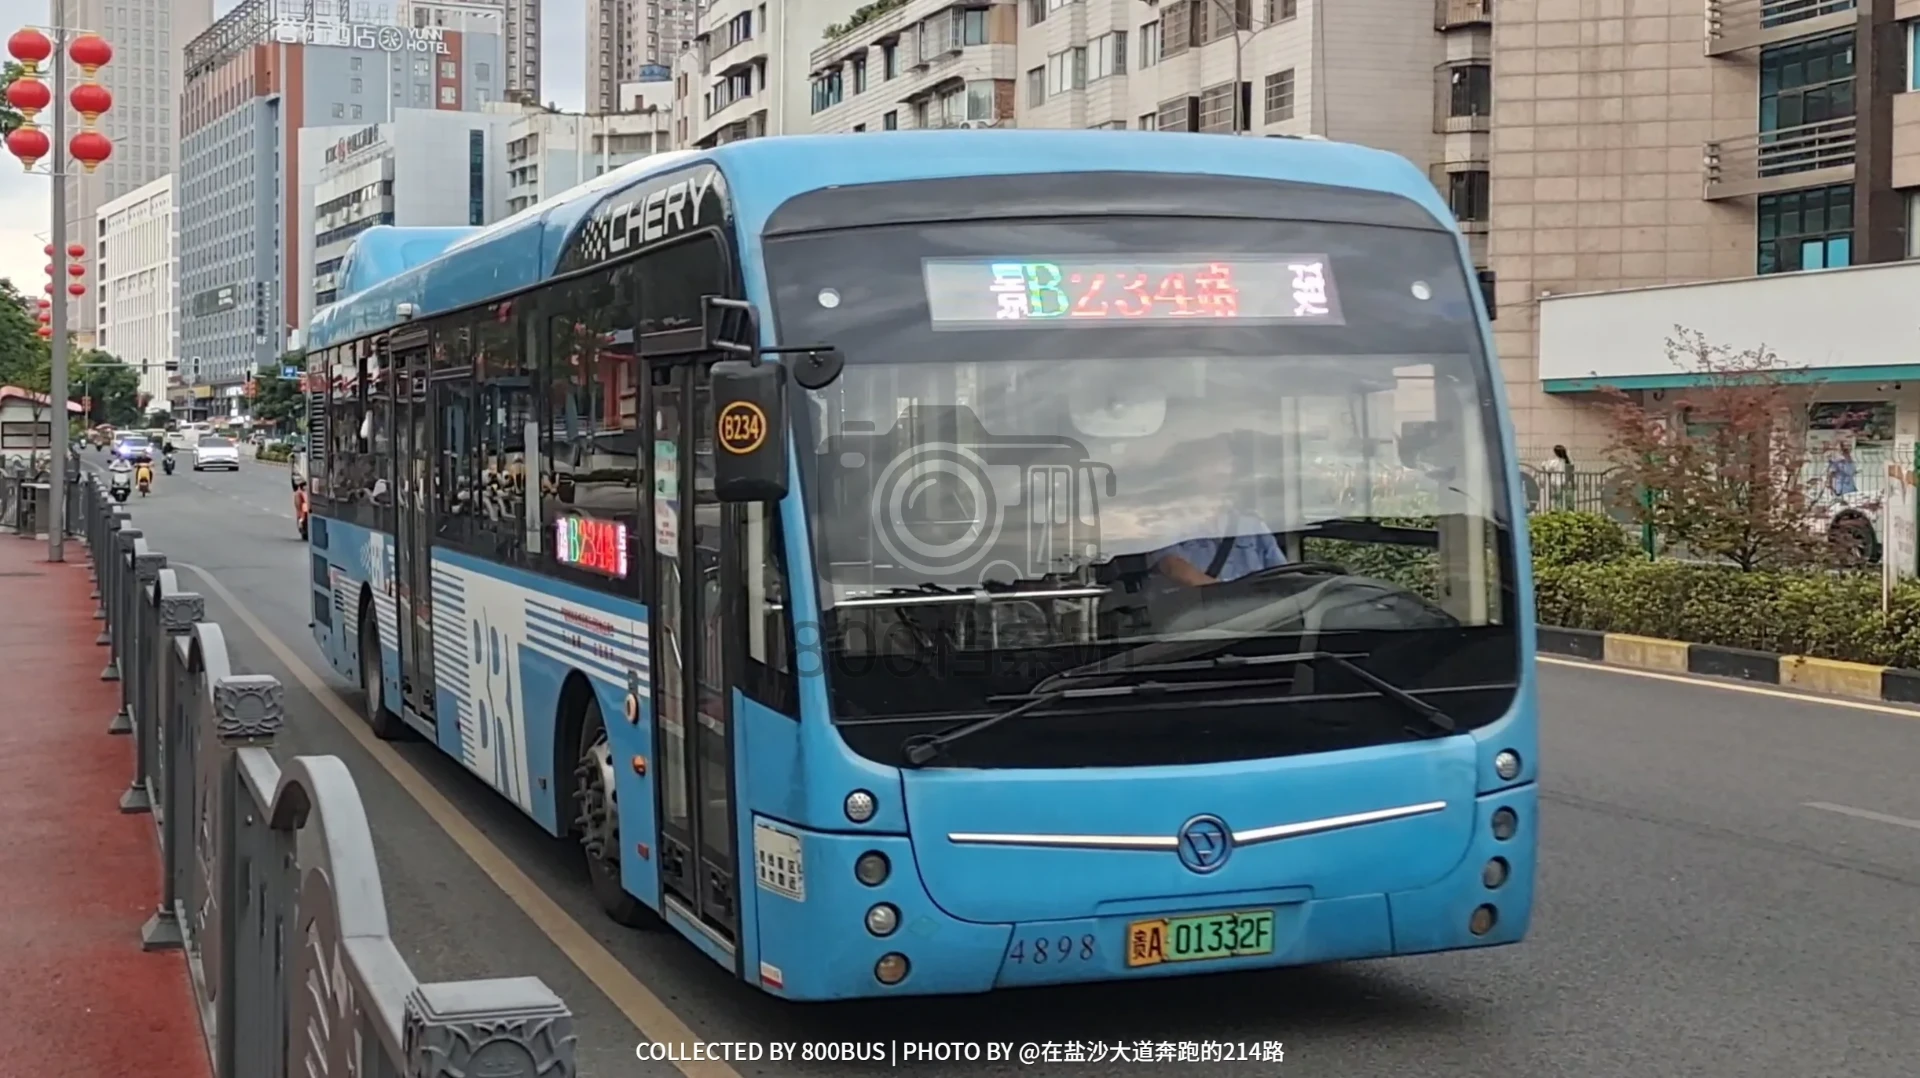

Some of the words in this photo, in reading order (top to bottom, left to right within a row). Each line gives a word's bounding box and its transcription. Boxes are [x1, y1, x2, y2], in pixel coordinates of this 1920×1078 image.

[406, 40, 452, 55] HOTEL
[609, 168, 717, 253] CHERY
[725, 414, 759, 440] B234
[1009, 933, 1095, 965] 4898
